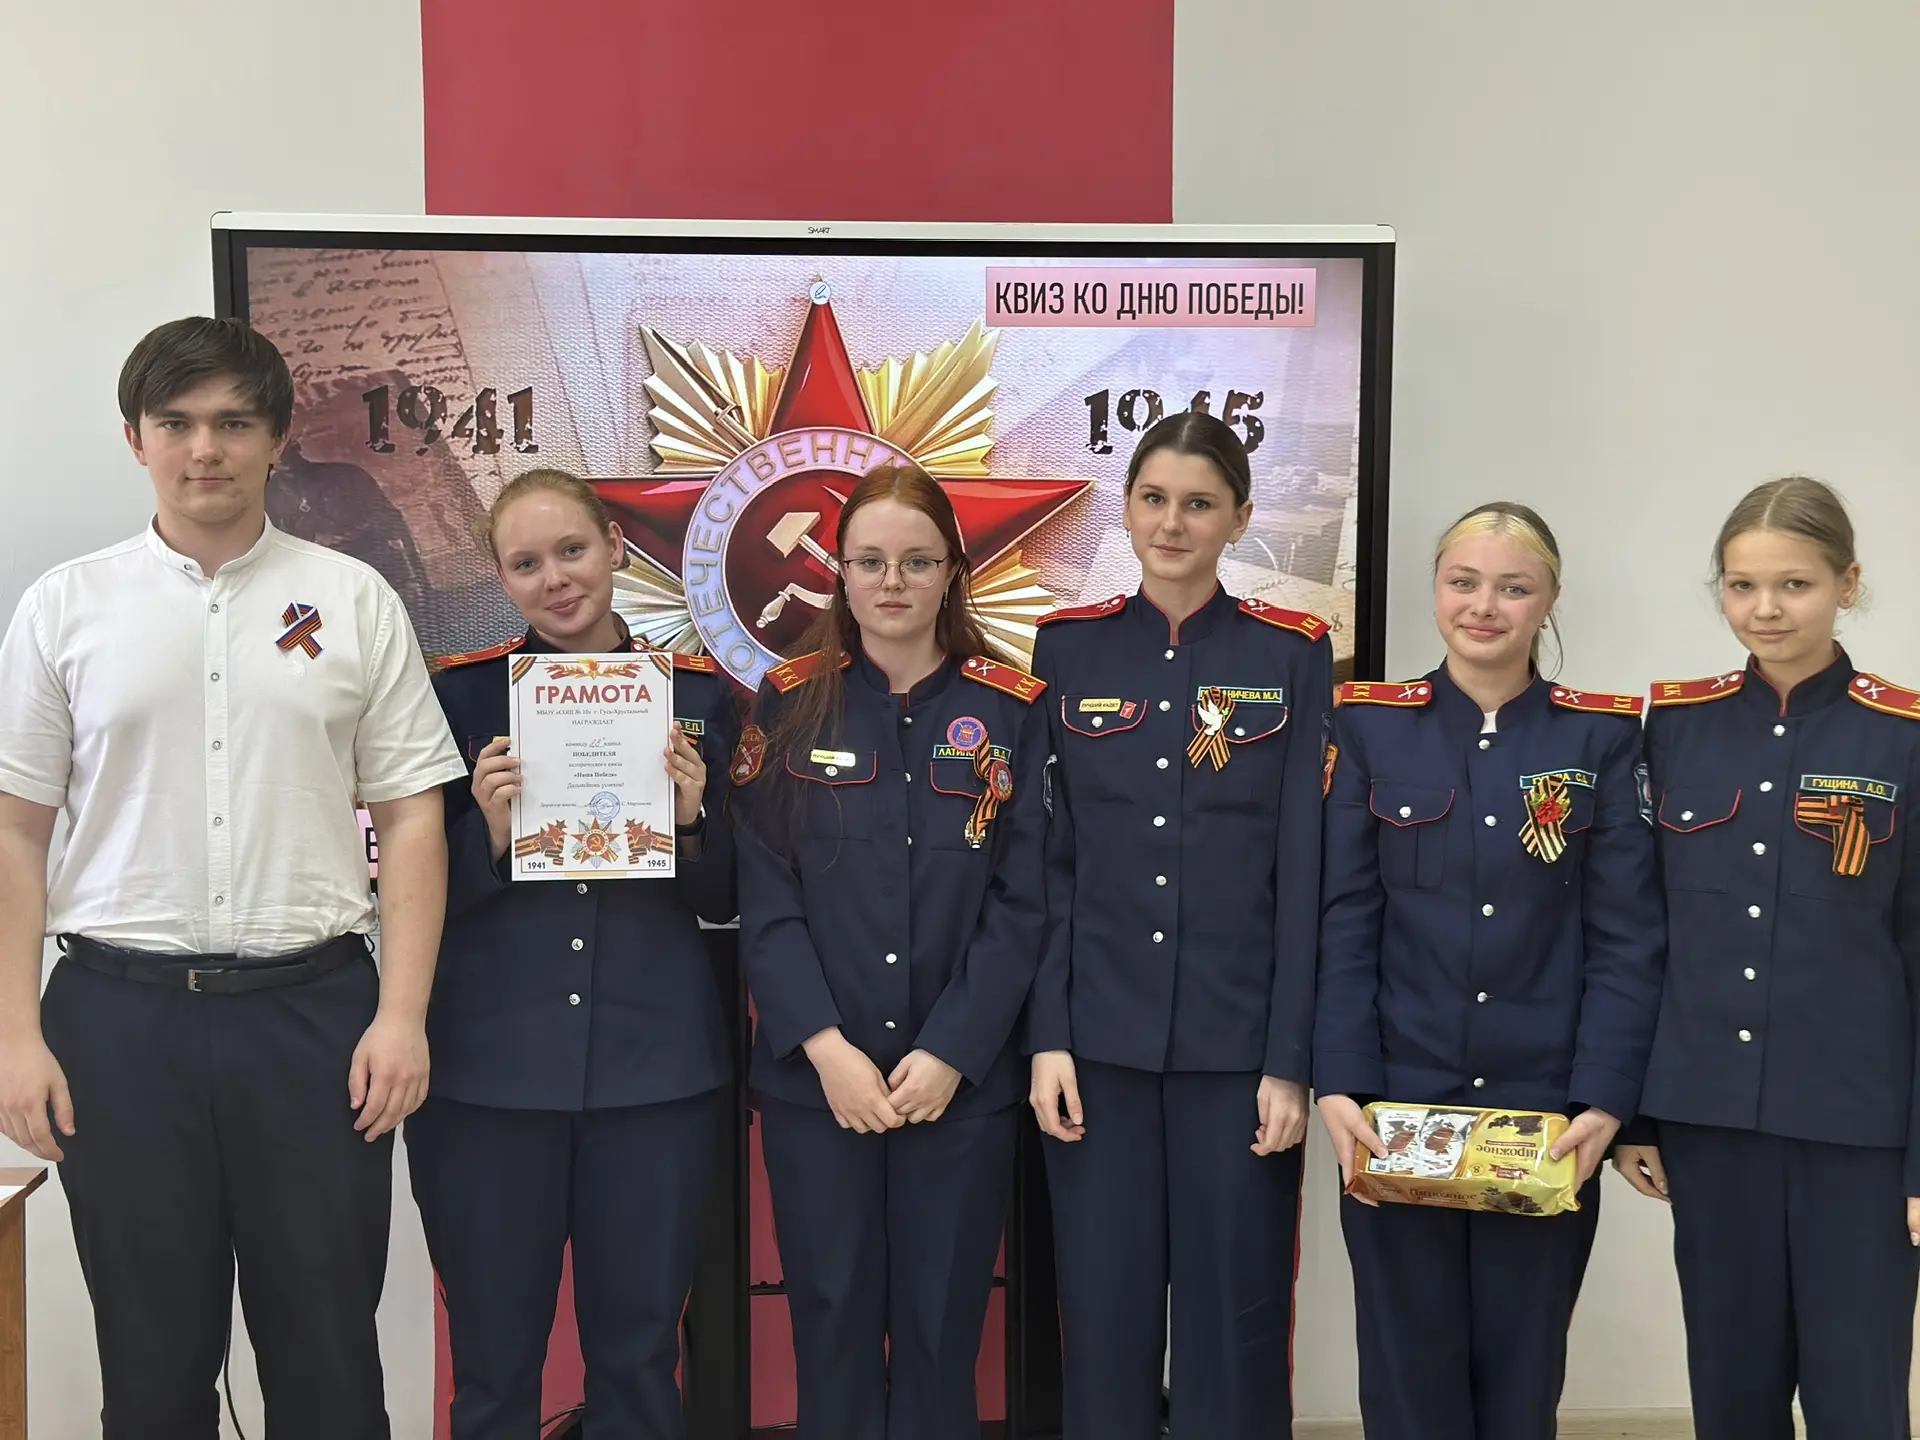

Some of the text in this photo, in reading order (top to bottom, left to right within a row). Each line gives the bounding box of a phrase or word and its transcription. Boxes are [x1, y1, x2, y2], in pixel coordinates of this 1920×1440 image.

[808, 226, 831, 234] SMART
[996, 282, 1304, 320] КВИЗ КО ДНЮ ПОБЕДЫ!
[362, 384, 539, 454] 1941
[535, 684, 653, 704] ГРАМОТА
[1812, 778, 1859, 790] ГУЩИНА
[647, 860, 666, 868] 1945
